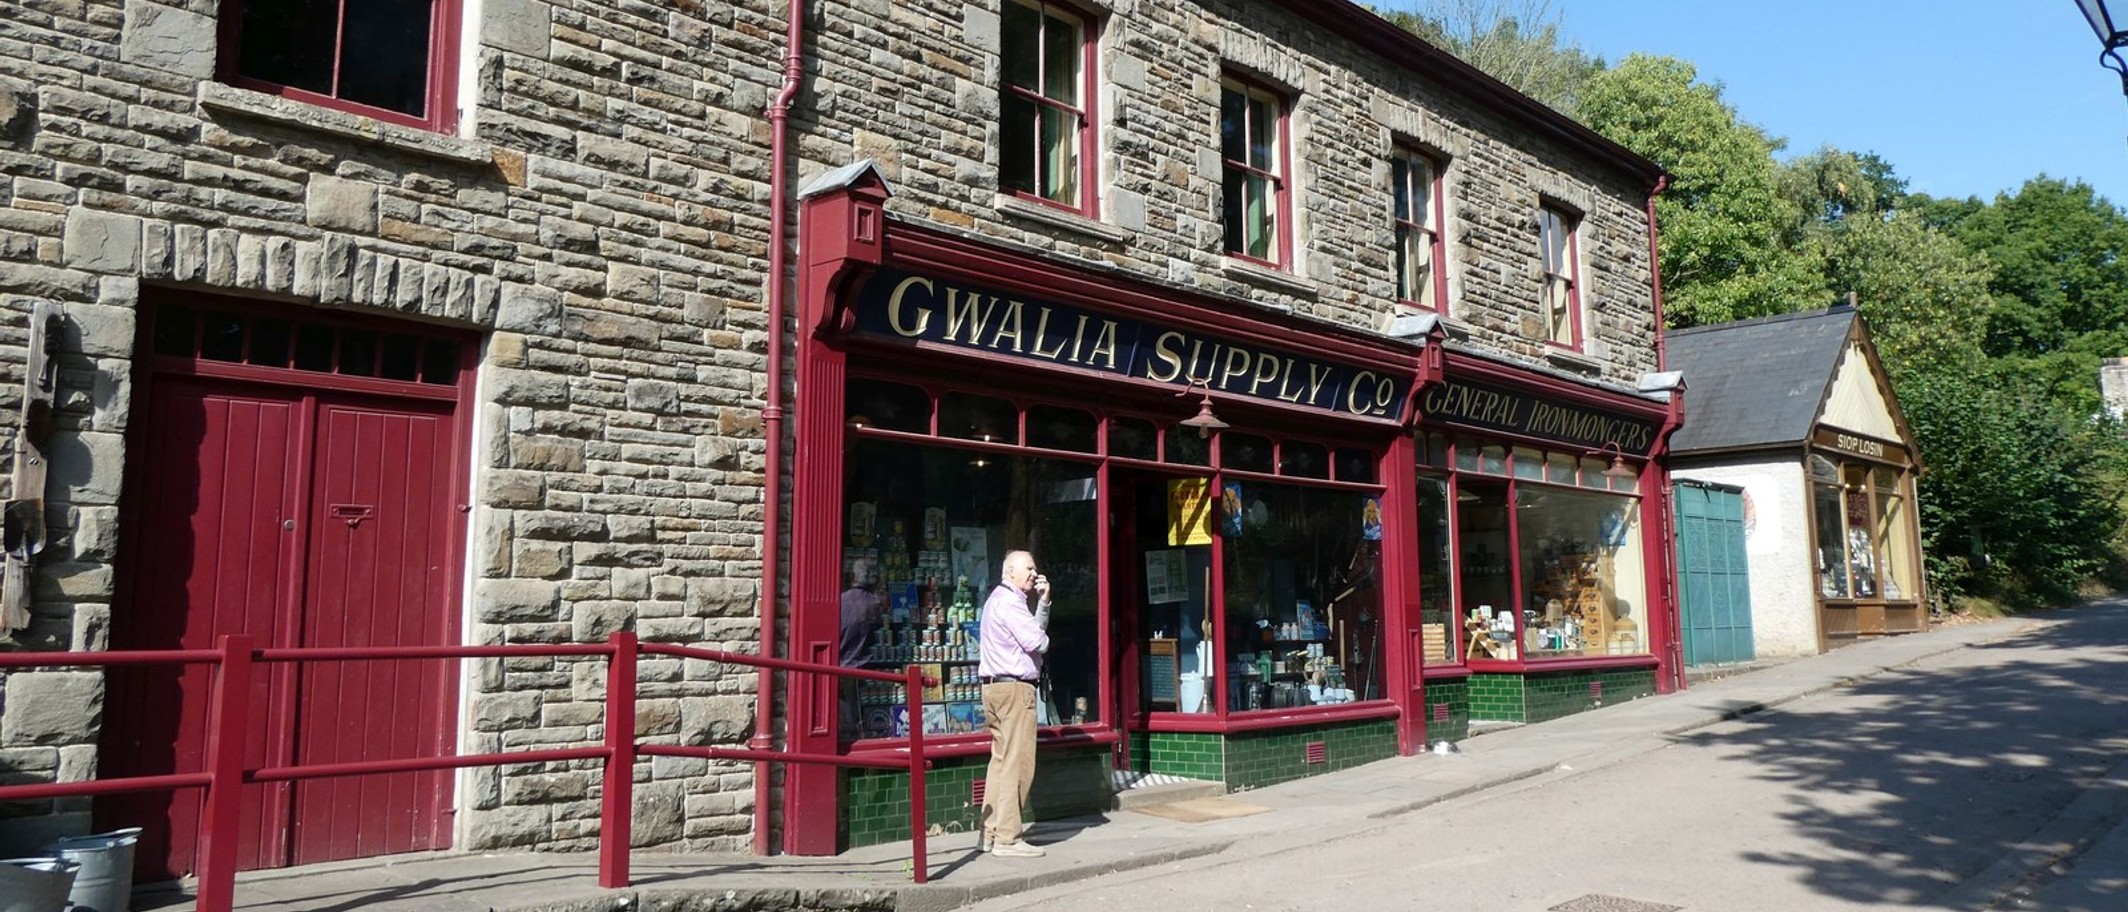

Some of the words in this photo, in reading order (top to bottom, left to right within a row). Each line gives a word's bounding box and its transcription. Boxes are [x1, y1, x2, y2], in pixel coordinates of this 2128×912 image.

[888, 276, 1118, 369] GWALIA
[1147, 331, 1332, 404] SUPPLY
[1425, 380, 1521, 427] GENERAL
[1525, 400, 1651, 450] IRONMONGERS
[1837, 434, 1858, 451] SIOP
[1859, 438, 1883, 457] LOSIN
